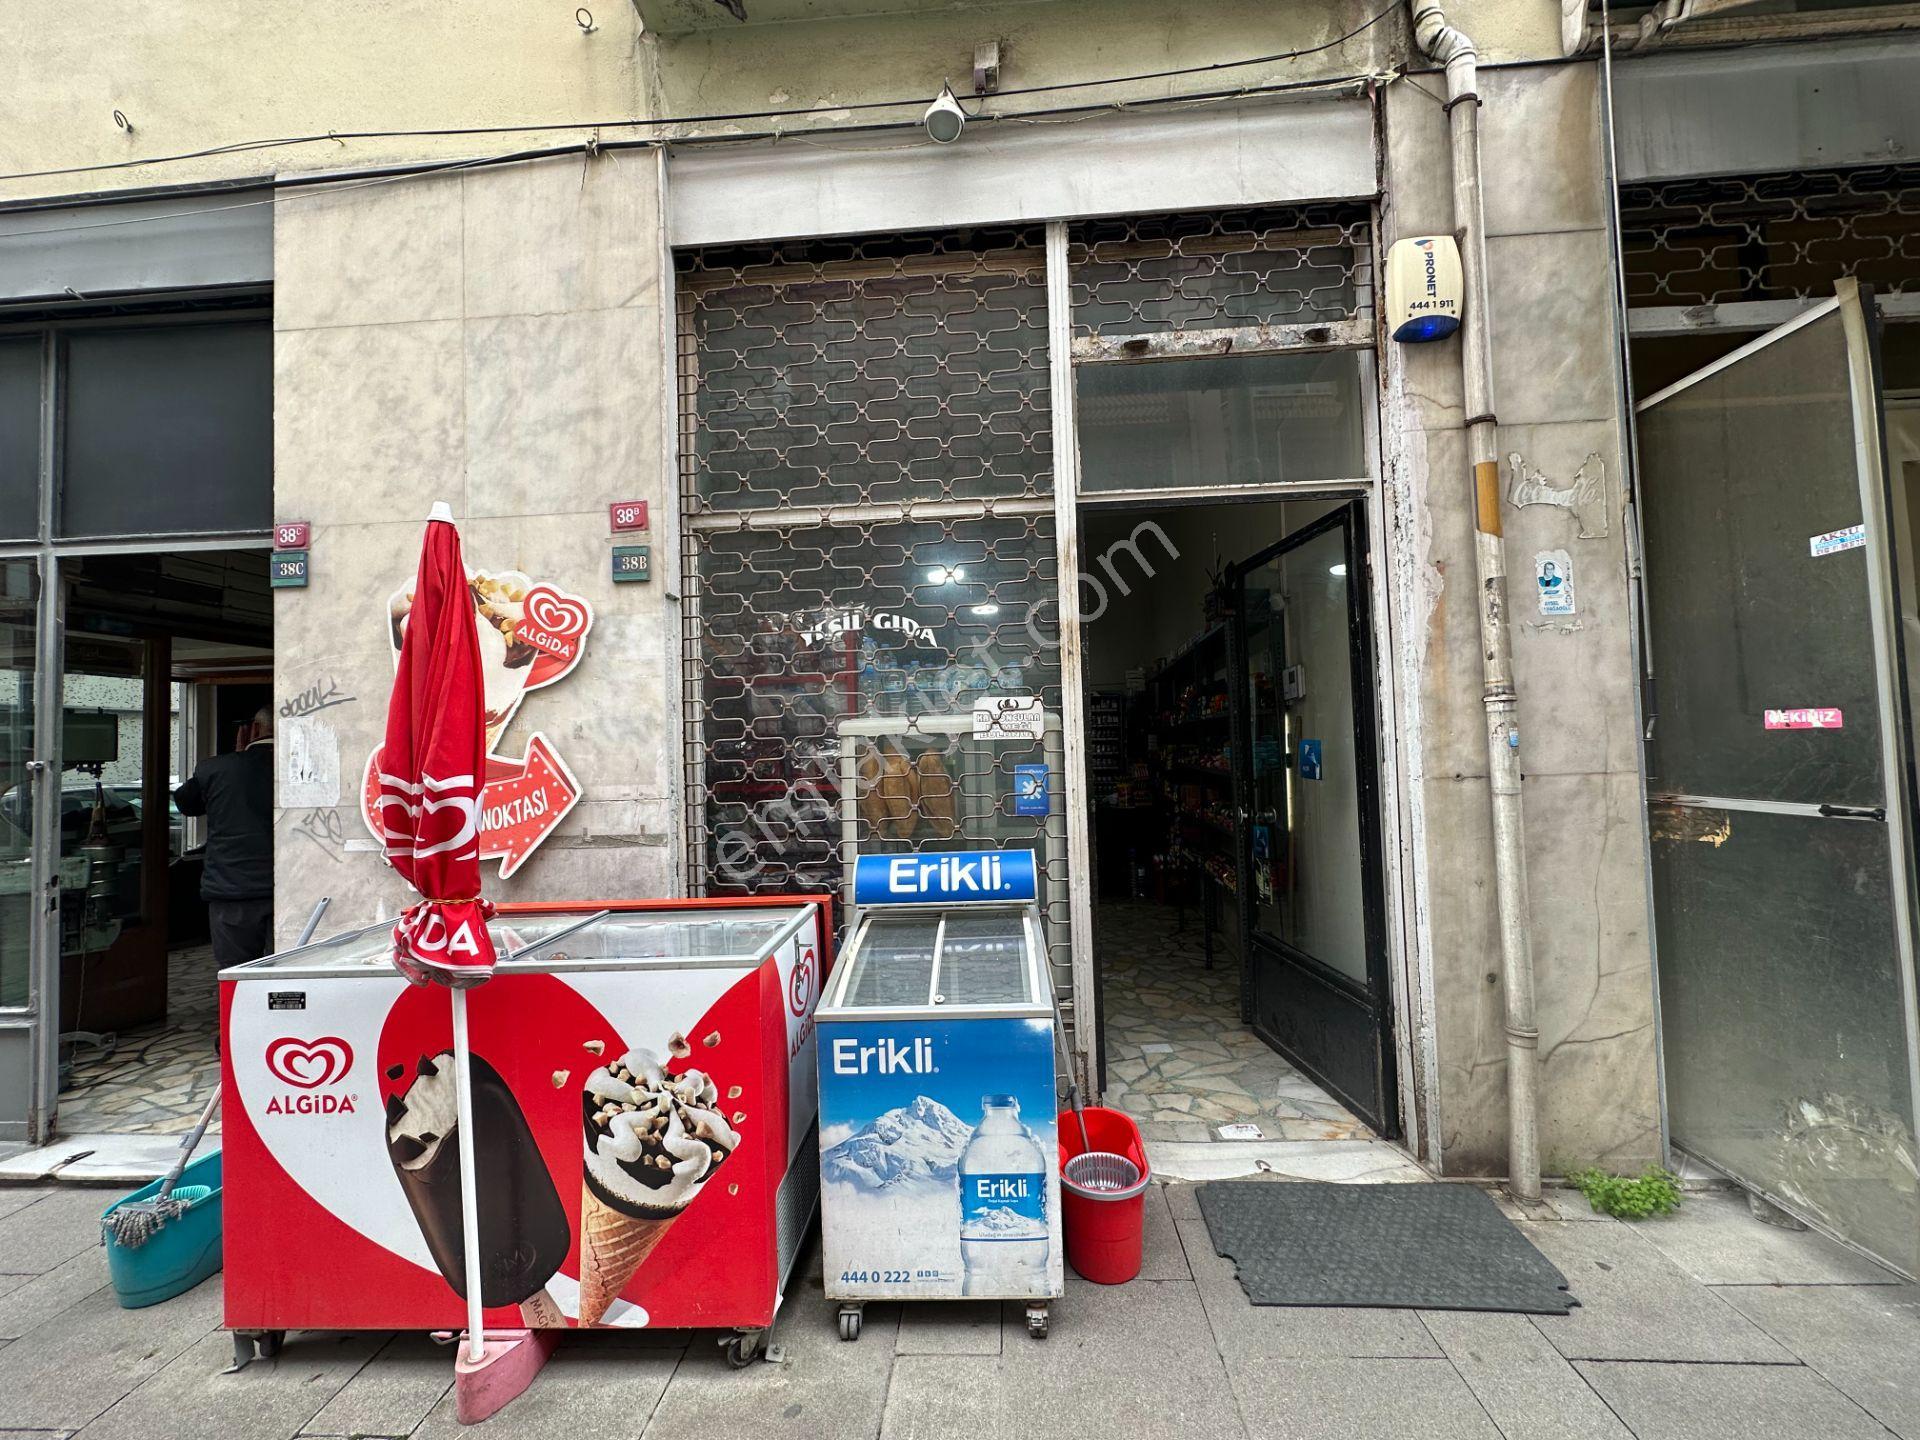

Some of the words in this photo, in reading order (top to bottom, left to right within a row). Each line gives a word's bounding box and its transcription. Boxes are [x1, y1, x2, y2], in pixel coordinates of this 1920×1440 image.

[1424, 251, 1436, 297] PRONET
[1409, 301, 1430, 309] 444
[1440, 300, 1454, 308] 911
[1819, 526, 1859, 543] AKSU
[280, 562, 304, 576] 38C
[622, 555, 648, 570] 38B
[873, 612, 938, 648] GIDA
[888, 855, 1003, 893] Erikli
[831, 1037, 933, 1075] Erikli
[976, 1179, 1028, 1198] Erikli
[841, 1271, 868, 1283] 444
[871, 1271, 880, 1283] 0
[884, 1271, 911, 1283] 222
